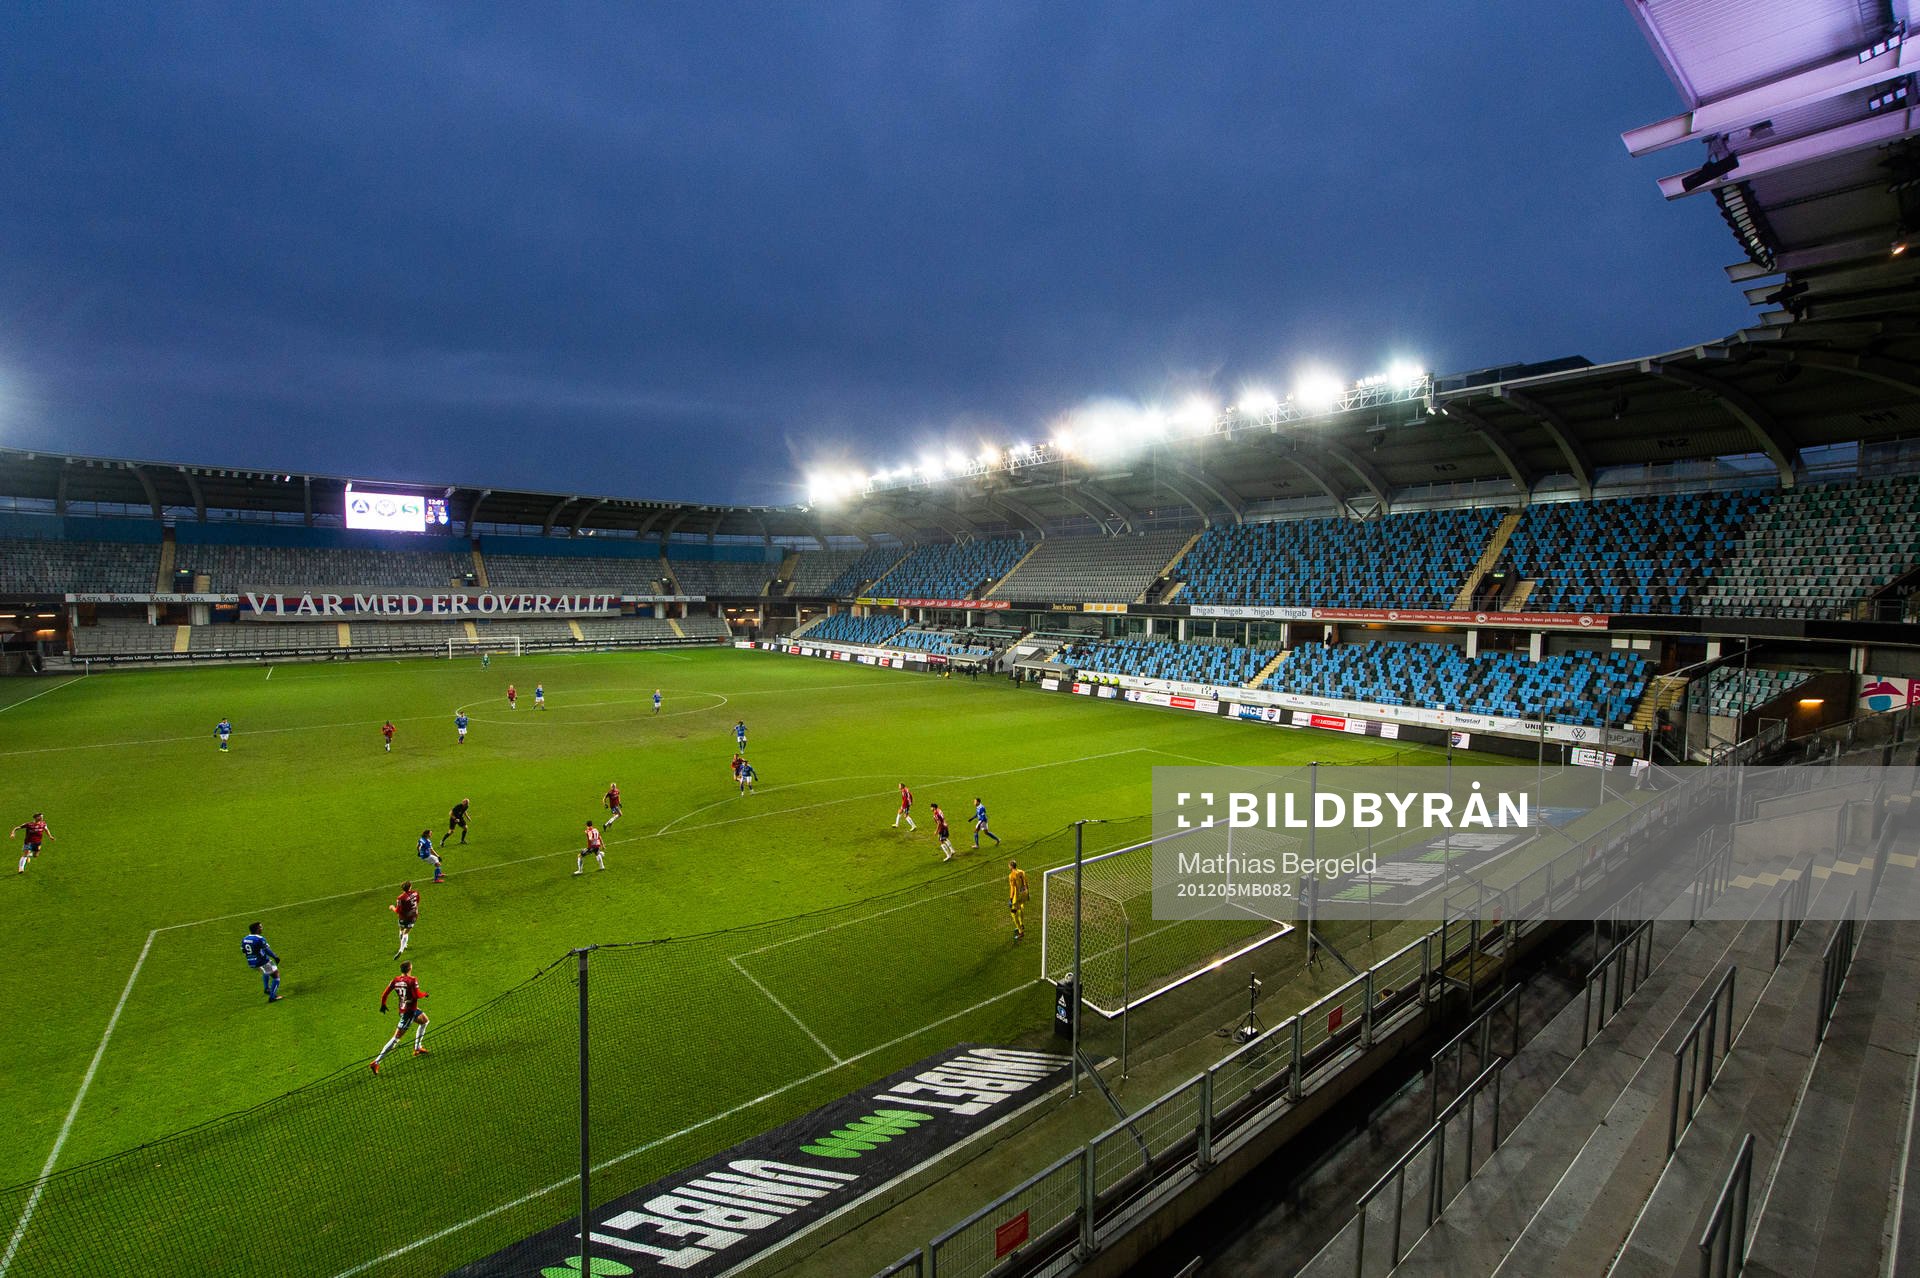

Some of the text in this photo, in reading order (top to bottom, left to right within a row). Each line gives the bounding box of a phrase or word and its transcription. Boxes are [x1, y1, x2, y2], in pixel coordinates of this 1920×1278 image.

[246, 590, 614, 616] VI ÄR MED ER ÖVERALLT
[1197, 607, 1215, 616] higab
[1224, 608, 1243, 616] higab
[1254, 608, 1274, 617] higab
[1285, 610, 1307, 618] higab
[245, 944, 252, 954] 9
[873, 1048, 1073, 1116] UNIBET
[576, 1159, 860, 1270] UNIBET
